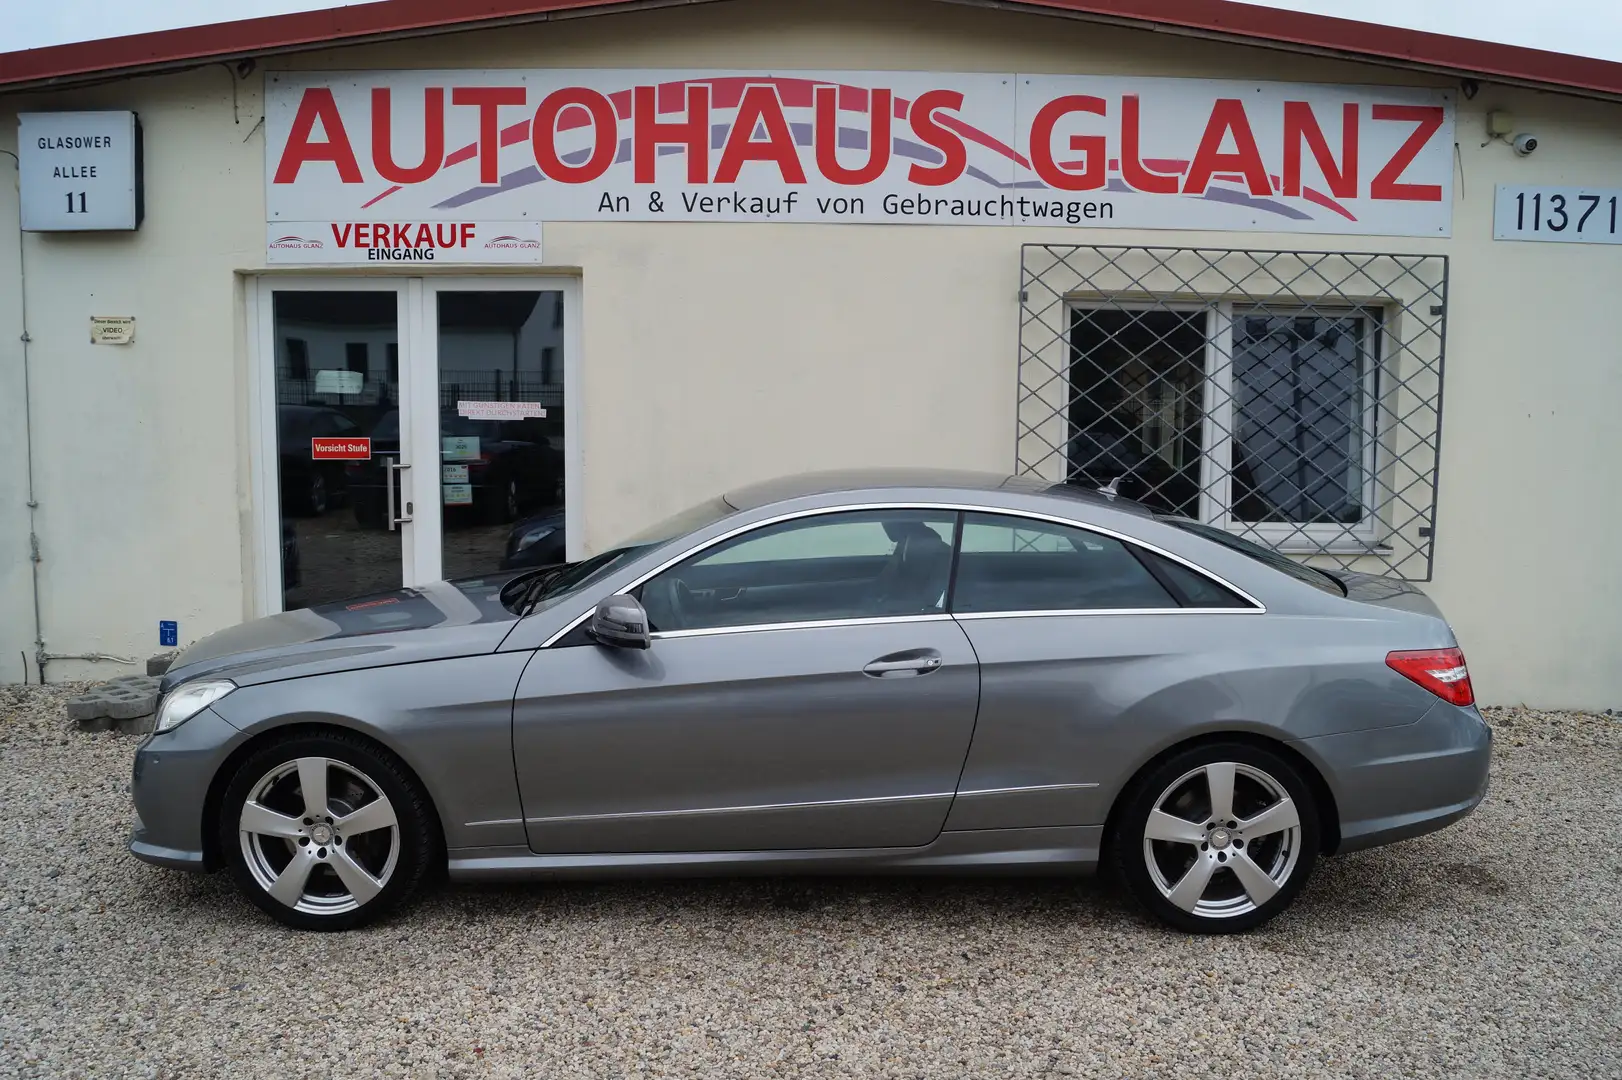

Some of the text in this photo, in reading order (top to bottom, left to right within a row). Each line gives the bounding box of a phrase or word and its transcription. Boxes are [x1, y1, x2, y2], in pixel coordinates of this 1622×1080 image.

[37, 136, 112, 150] GLASOWER
[273, 84, 1444, 202] AUTOHAUS GLANZ
[53, 165, 98, 179] ALLEE
[65, 191, 89, 214] 11
[597, 190, 1115, 225] An & Verkauf von Gebrauchtwagen
[1515, 192, 1618, 234] 11371
[331, 222, 476, 249] VERKAUF
[303, 242, 324, 250] GLANZ
[367, 248, 435, 261] EINGANG
[314, 443, 368, 452] Vorsicht Stufe
